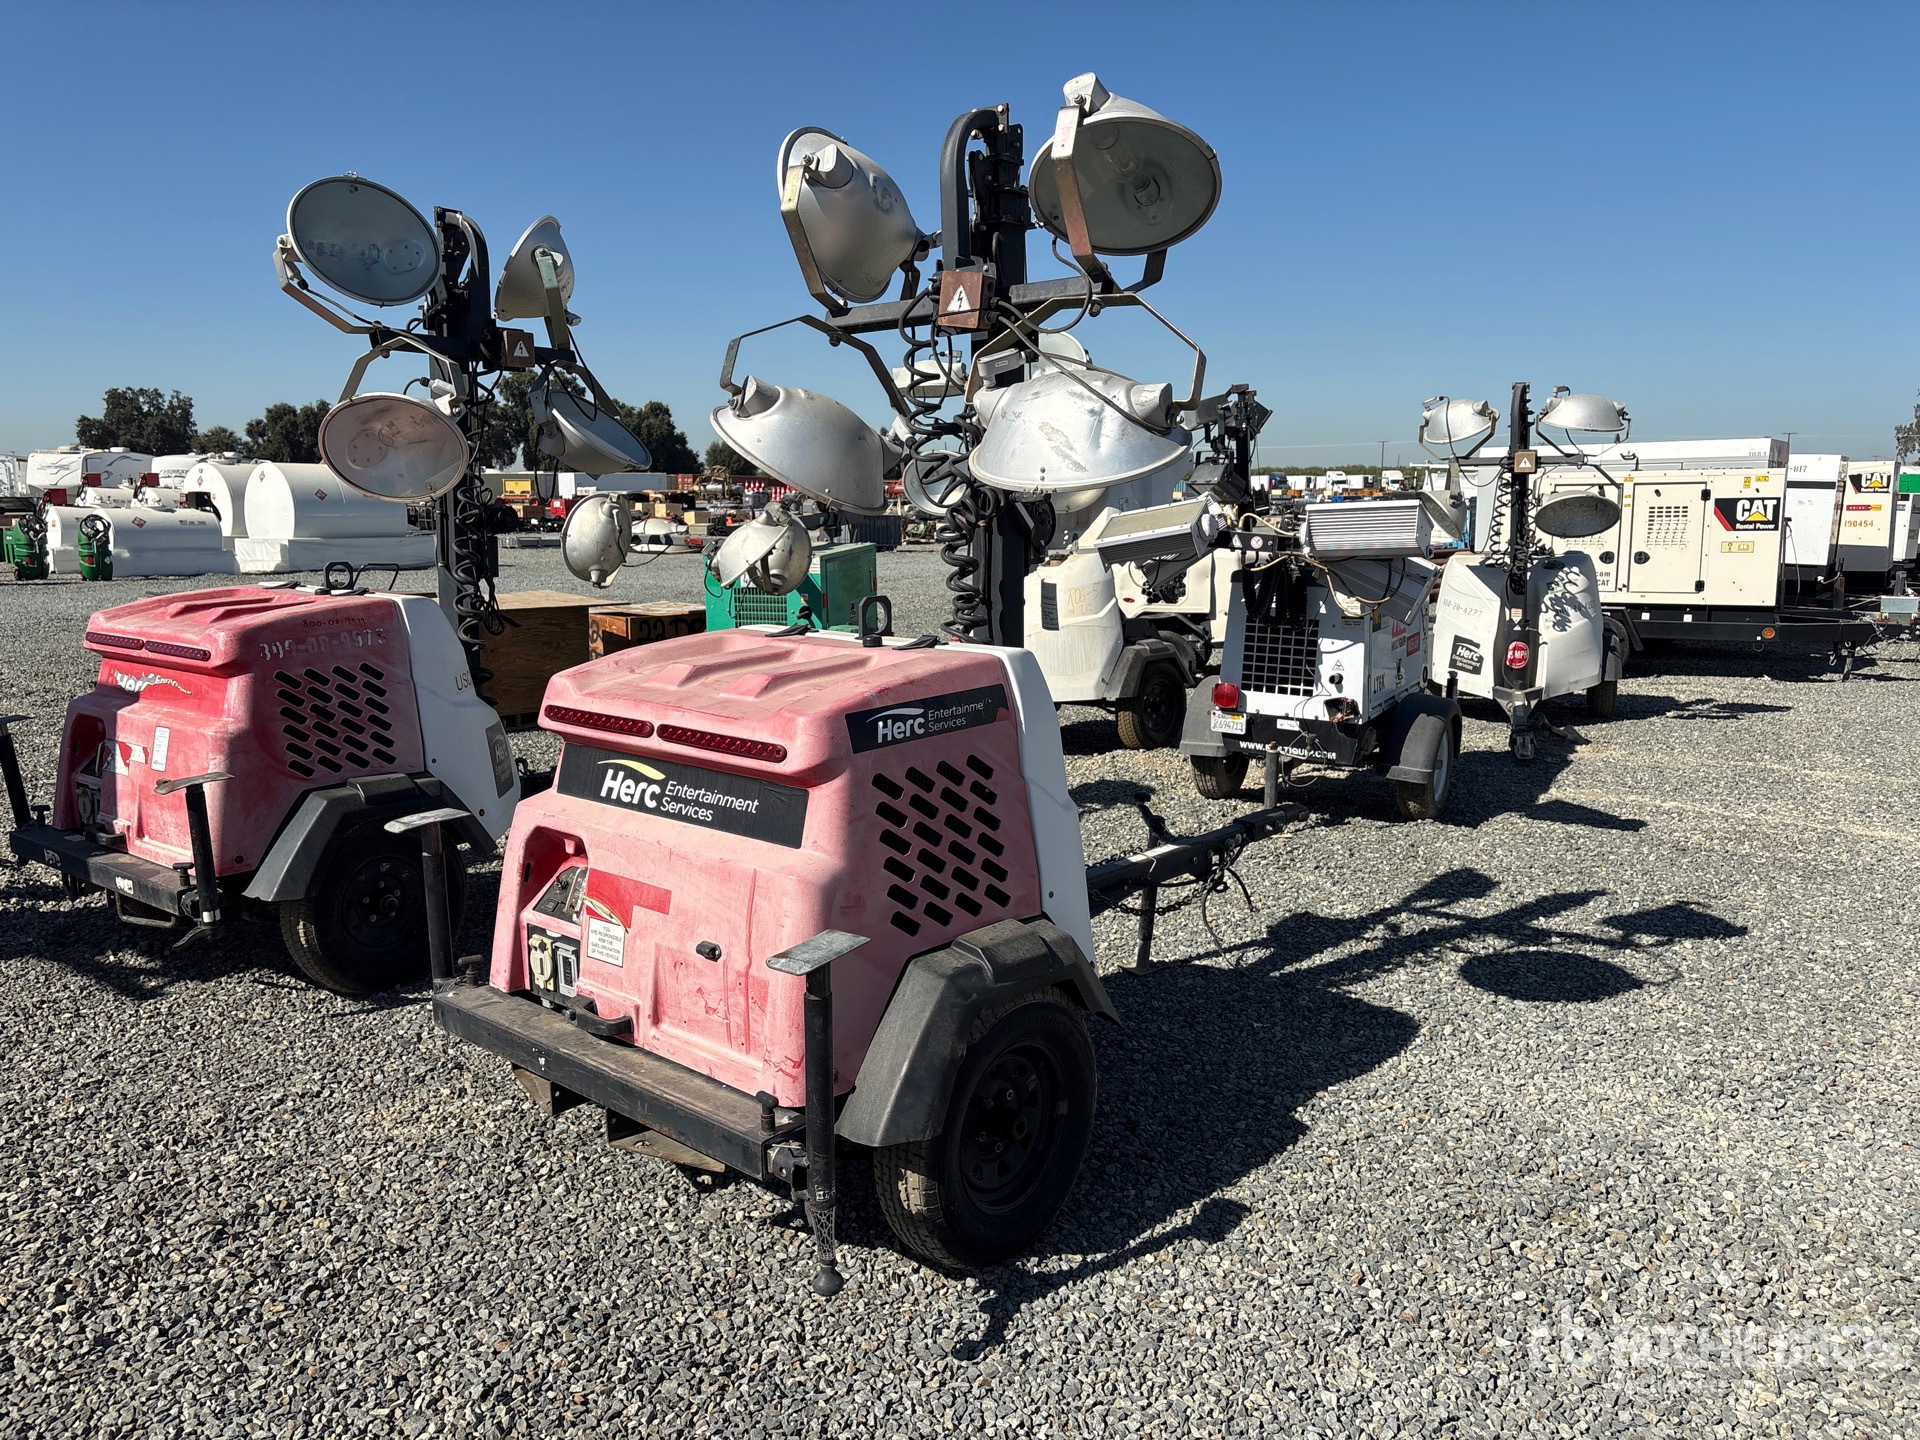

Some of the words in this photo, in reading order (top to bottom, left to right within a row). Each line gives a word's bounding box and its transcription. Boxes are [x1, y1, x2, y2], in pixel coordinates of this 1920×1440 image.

[1861, 472, 1889, 488] CAT
[1735, 499, 1778, 522] CAT
[1735, 522, 1755, 530] Rental
[1456, 646, 1480, 661] Herc
[928, 698, 991, 721] Entertainme
[877, 717, 926, 744] Herc
[928, 717, 967, 733] Services
[1239, 741, 1337, 760] WWW.LTIQUIP.COM
[600, 768, 662, 809] Herc
[665, 780, 760, 814] Entertainment
[660, 797, 714, 822] Services
